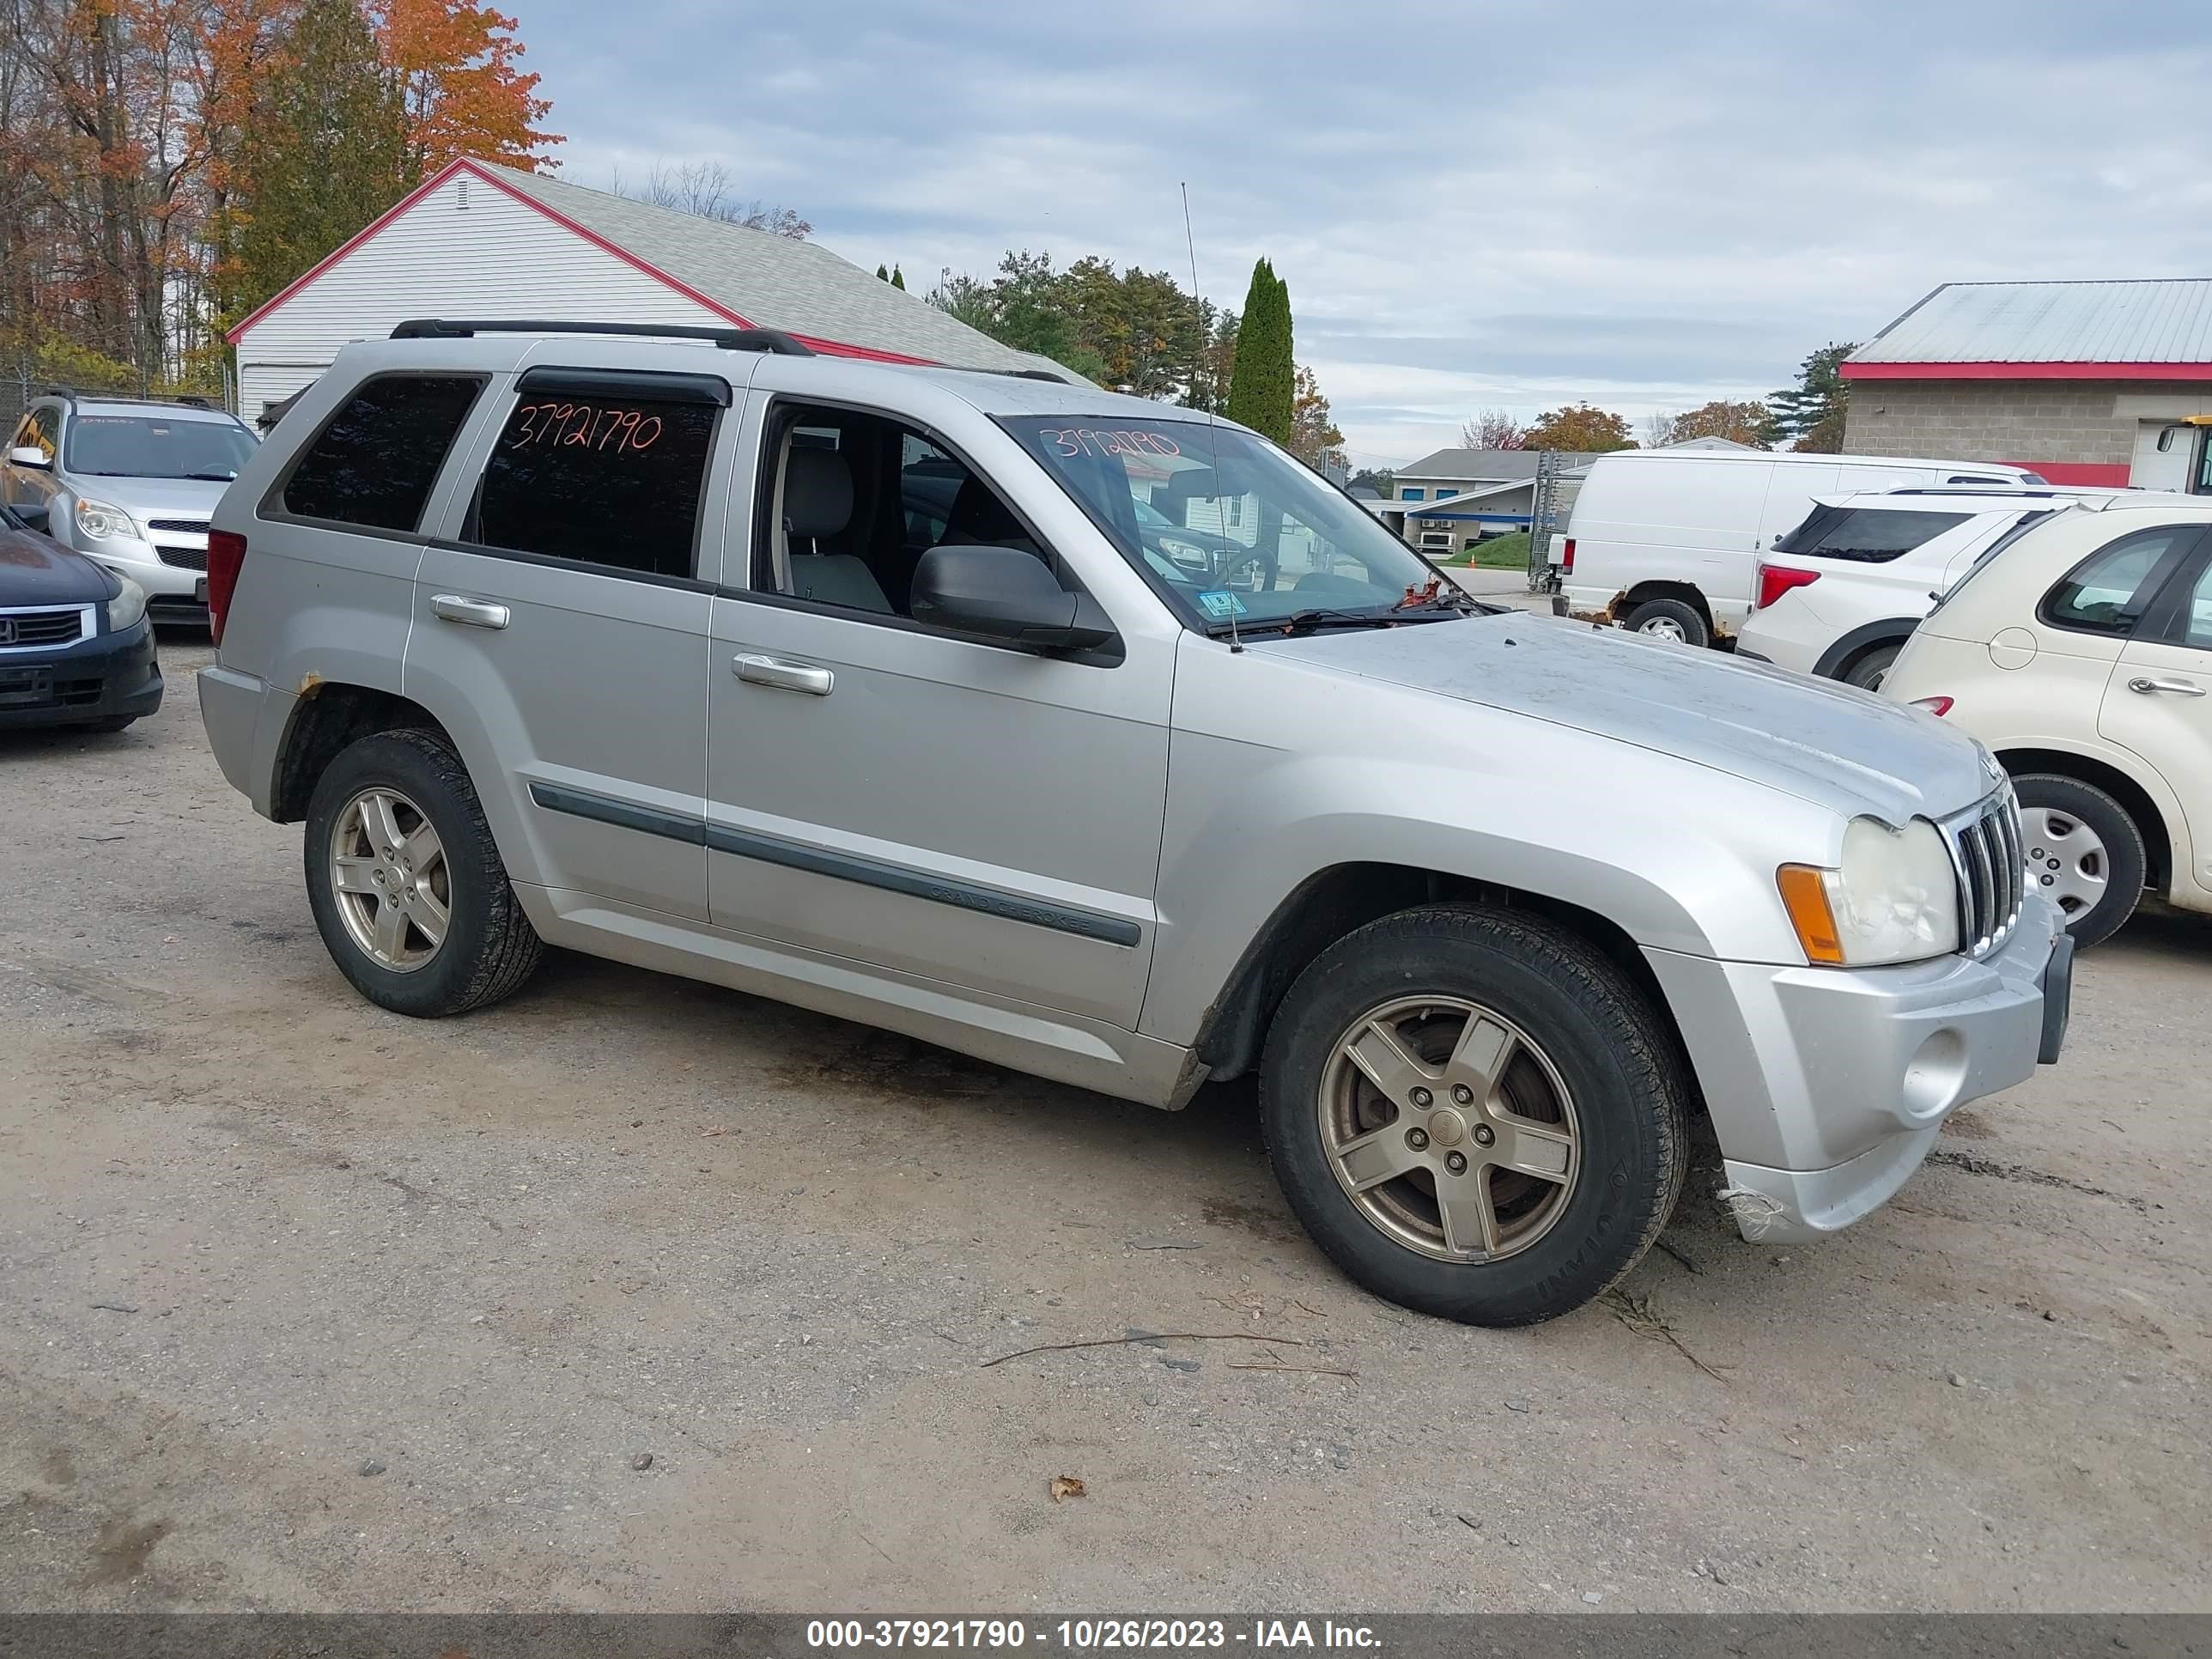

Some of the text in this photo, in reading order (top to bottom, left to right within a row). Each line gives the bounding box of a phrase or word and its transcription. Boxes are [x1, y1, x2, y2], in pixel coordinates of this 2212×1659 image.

[512, 404, 661, 453] 37921790
[929, 885, 1092, 932] GRAND CHEROKEE
